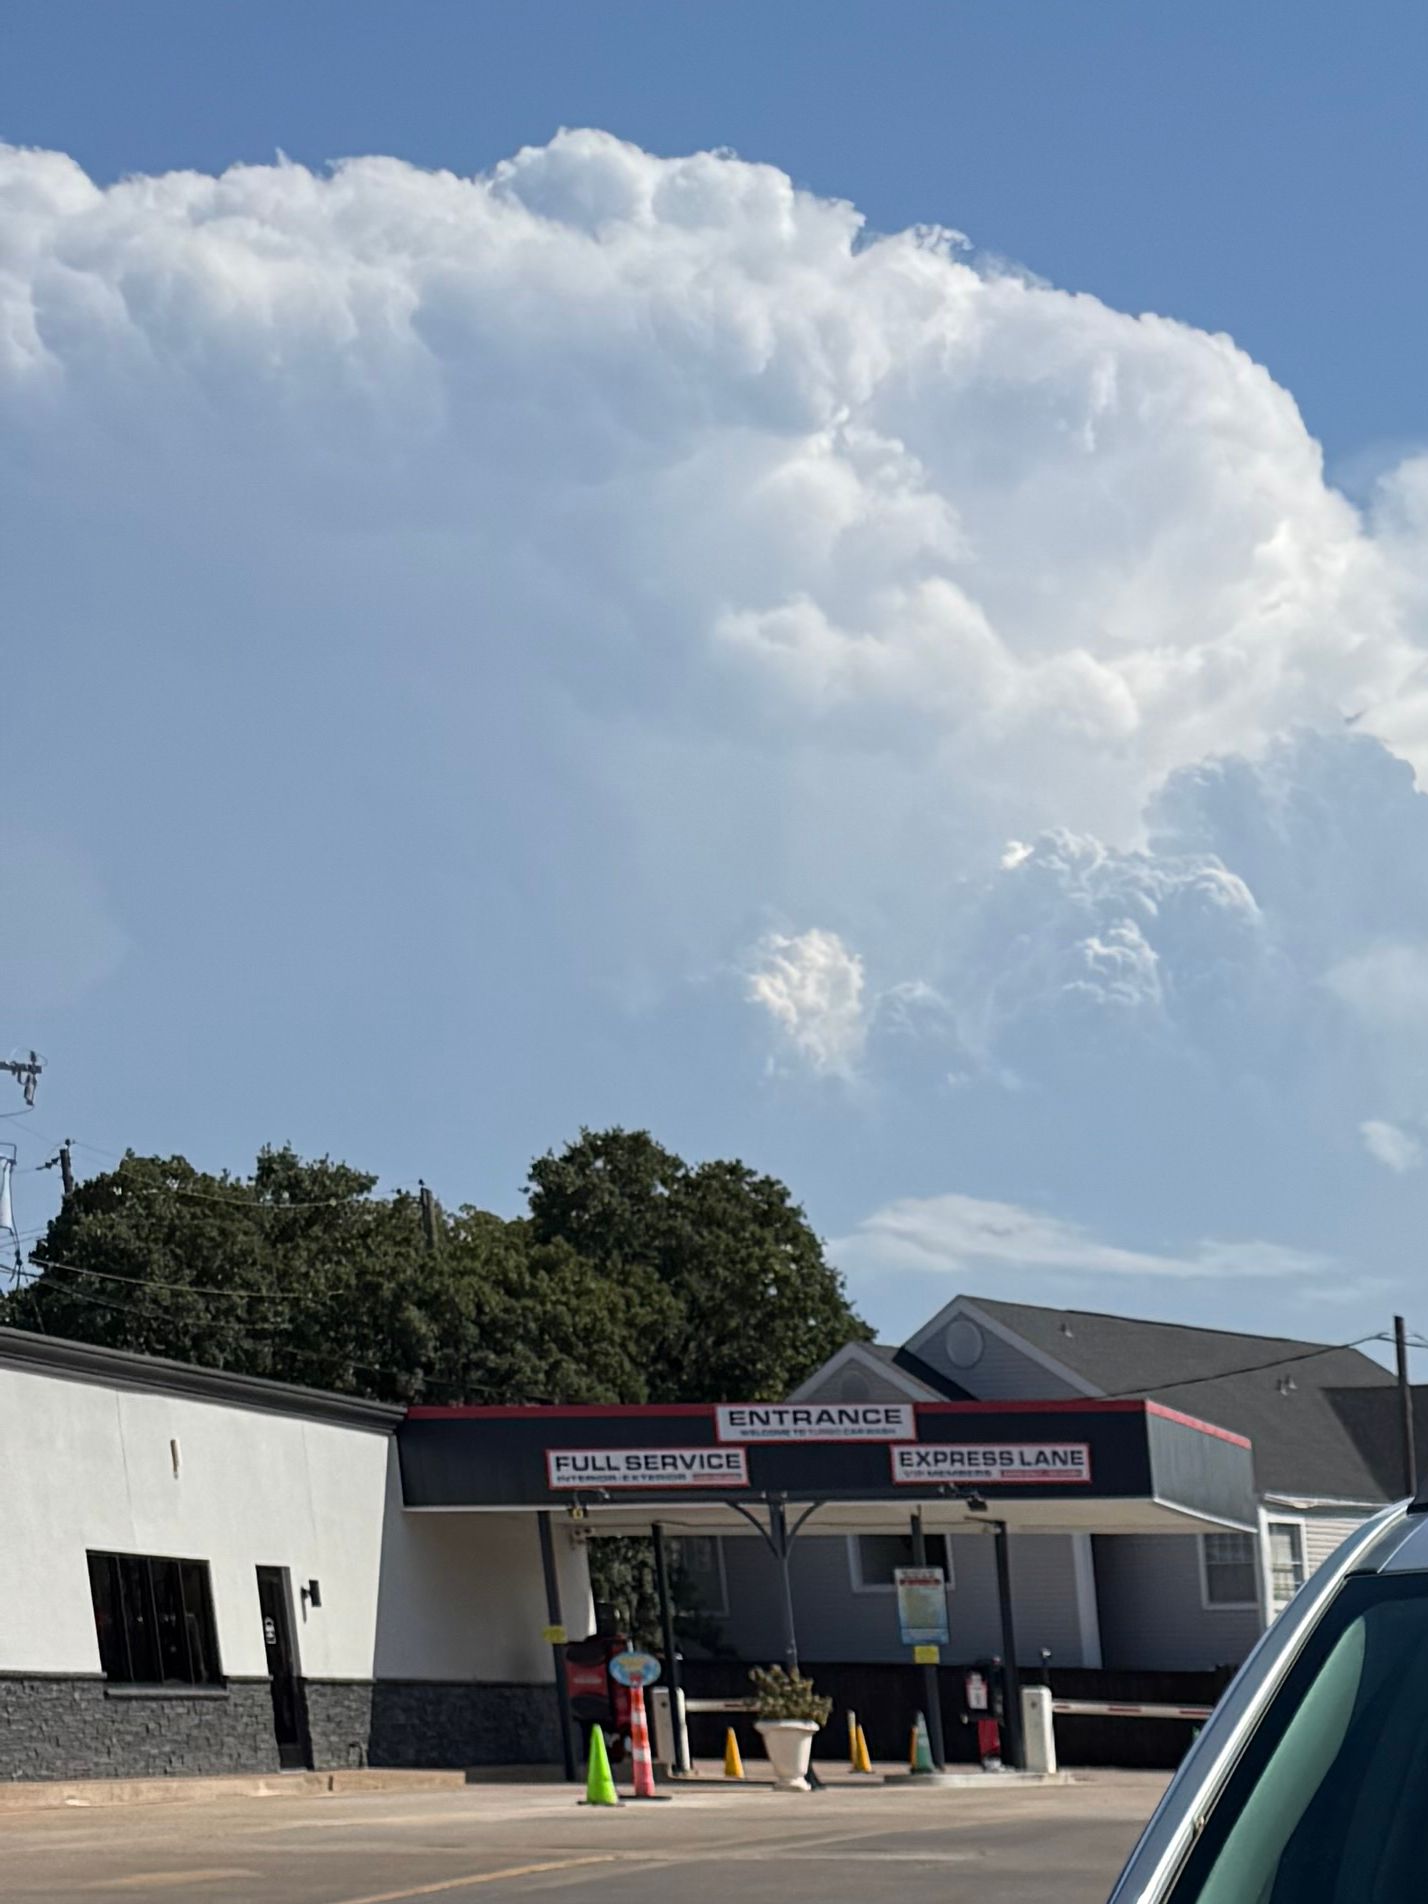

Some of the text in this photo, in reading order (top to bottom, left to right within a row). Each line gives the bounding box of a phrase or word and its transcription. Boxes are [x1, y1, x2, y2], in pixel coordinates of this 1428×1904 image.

[729, 1409, 902, 1426] ENTRANCE
[556, 1454, 741, 1471] FULL SERVICE
[900, 1450, 1084, 1467] EXPRESS LANE
